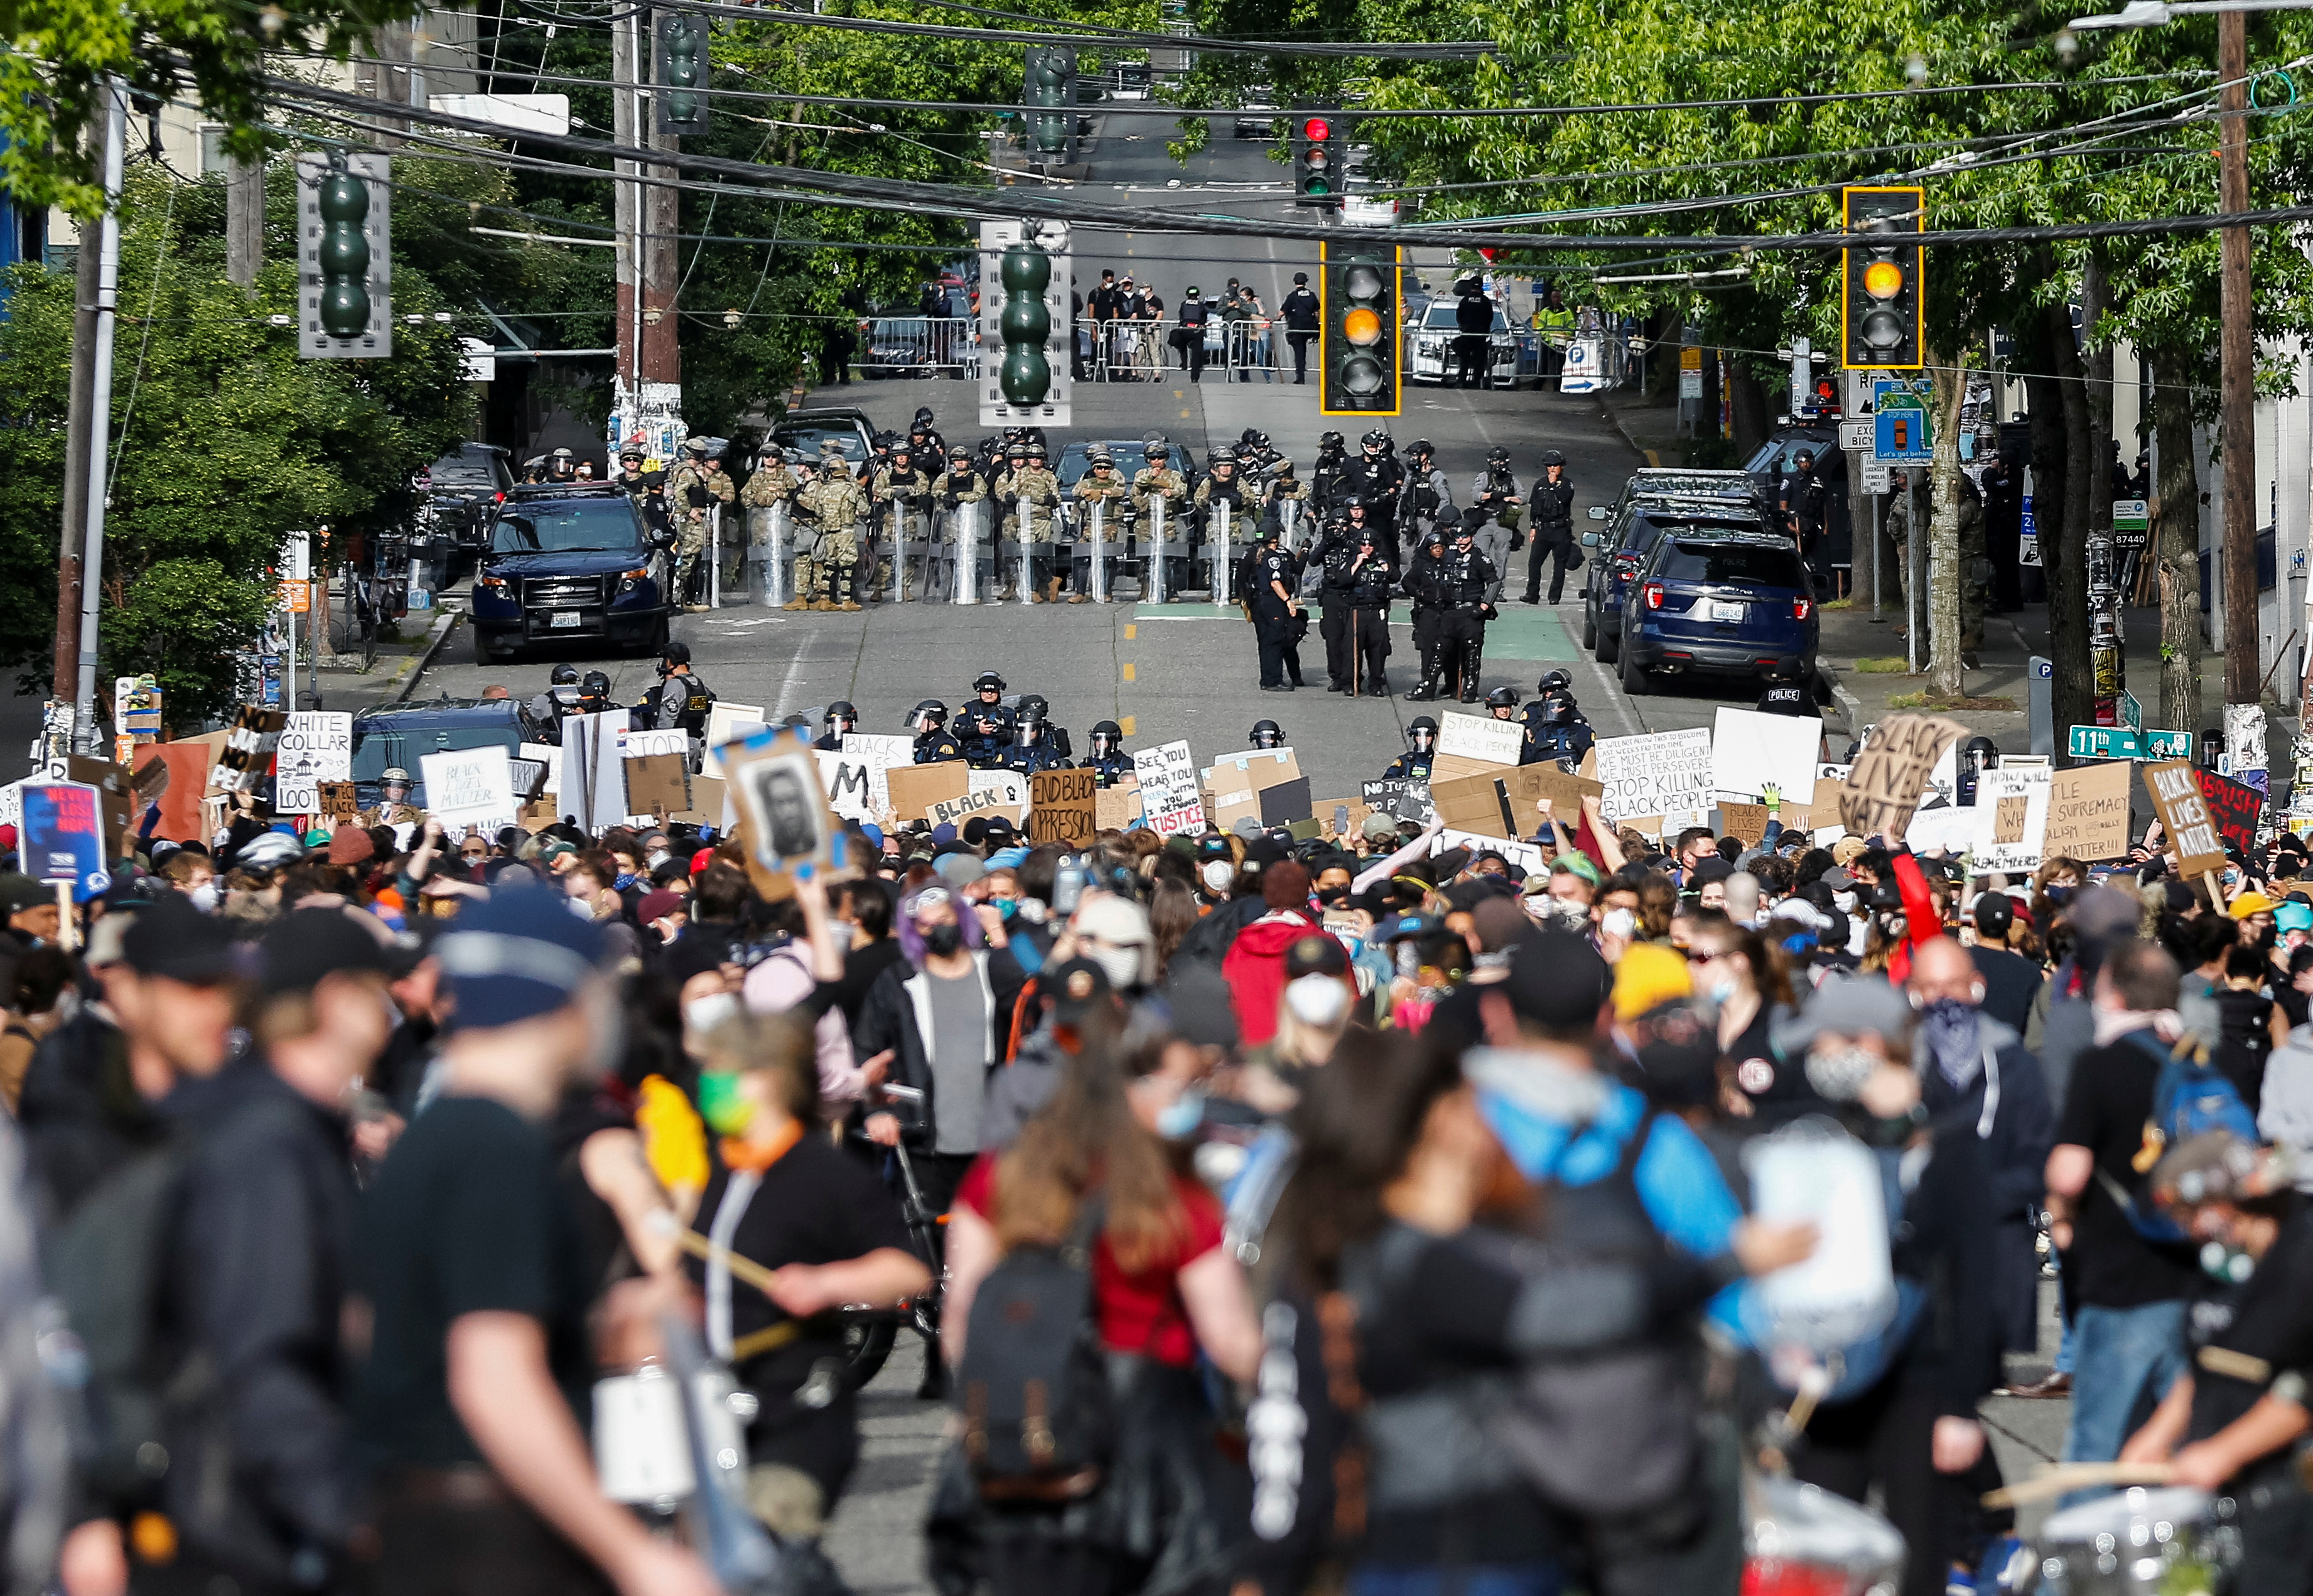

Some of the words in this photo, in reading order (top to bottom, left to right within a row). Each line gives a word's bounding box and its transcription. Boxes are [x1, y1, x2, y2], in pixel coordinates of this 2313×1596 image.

[1857, 426, 1874, 435] EXC
[2024, 517, 2031, 527] 2
[2042, 666, 2050, 676] P
[1771, 690, 1797, 700] POLICE
[282, 715, 343, 733] WHITE
[1446, 716, 1480, 730] STOP
[1483, 720, 1523, 738] KILLING
[280, 734, 349, 751] COLLAR
[627, 735, 683, 757] STOP
[846, 735, 902, 759] BLACK
[1443, 733, 1481, 752] BLACK
[1485, 740, 1522, 755] PEOPLE
[1605, 740, 1622, 748] WILL
[1678, 730, 1707, 740] BECOME
[1865, 720, 1955, 761] BLACK
[2078, 730, 2110, 753] 11th
[1137, 755, 1162, 770] SEE
[1163, 748, 1186, 764] YOU
[1597, 757, 1616, 768] WE
[1620, 752, 1648, 766] MUST
[1649, 751, 1663, 762] BE
[1665, 745, 1710, 760] DILIGENT
[445, 762, 482, 779] BLACK
[1170, 767, 1193, 782] YOU
[1599, 768, 1620, 780] WE
[1622, 764, 1649, 778] MUST
[1650, 757, 1712, 775] PERSEVERE
[1848, 756, 1931, 800] LIVES
[1990, 772, 2020, 784] HOW
[2023, 772, 2049, 783] WILL
[1033, 775, 1061, 804] END
[1062, 774, 1096, 801] BLACK
[1143, 790, 1168, 802] MOURN
[1171, 783, 1195, 794] WITH
[1363, 784, 1384, 797] NO
[1408, 784, 1426, 801] WE
[1603, 777, 1649, 800] STOP
[1655, 772, 1713, 794] KILLING
[2004, 784, 2026, 794] YOU
[2153, 767, 2196, 802] BLACK
[279, 788, 319, 809] LOOT
[1160, 797, 1199, 813] DEMAND
[1163, 794, 1183, 804] YOU
[1604, 796, 1661, 817] BLACK
[1664, 789, 1715, 812] PEOPLE
[2194, 770, 2262, 820] ABOLISH
[321, 802, 356, 815] BACK
[934, 789, 997, 822] BLACK
[1730, 804, 1761, 817] BLACK
[2057, 795, 2128, 822] SUPREMACY
[2166, 795, 2206, 829] LIVES
[1030, 809, 1096, 841] OPPRESSION
[1730, 818, 1760, 829] LIVES
[1729, 829, 1760, 843] MATTER
[2061, 839, 2118, 859] MATTER!!!
